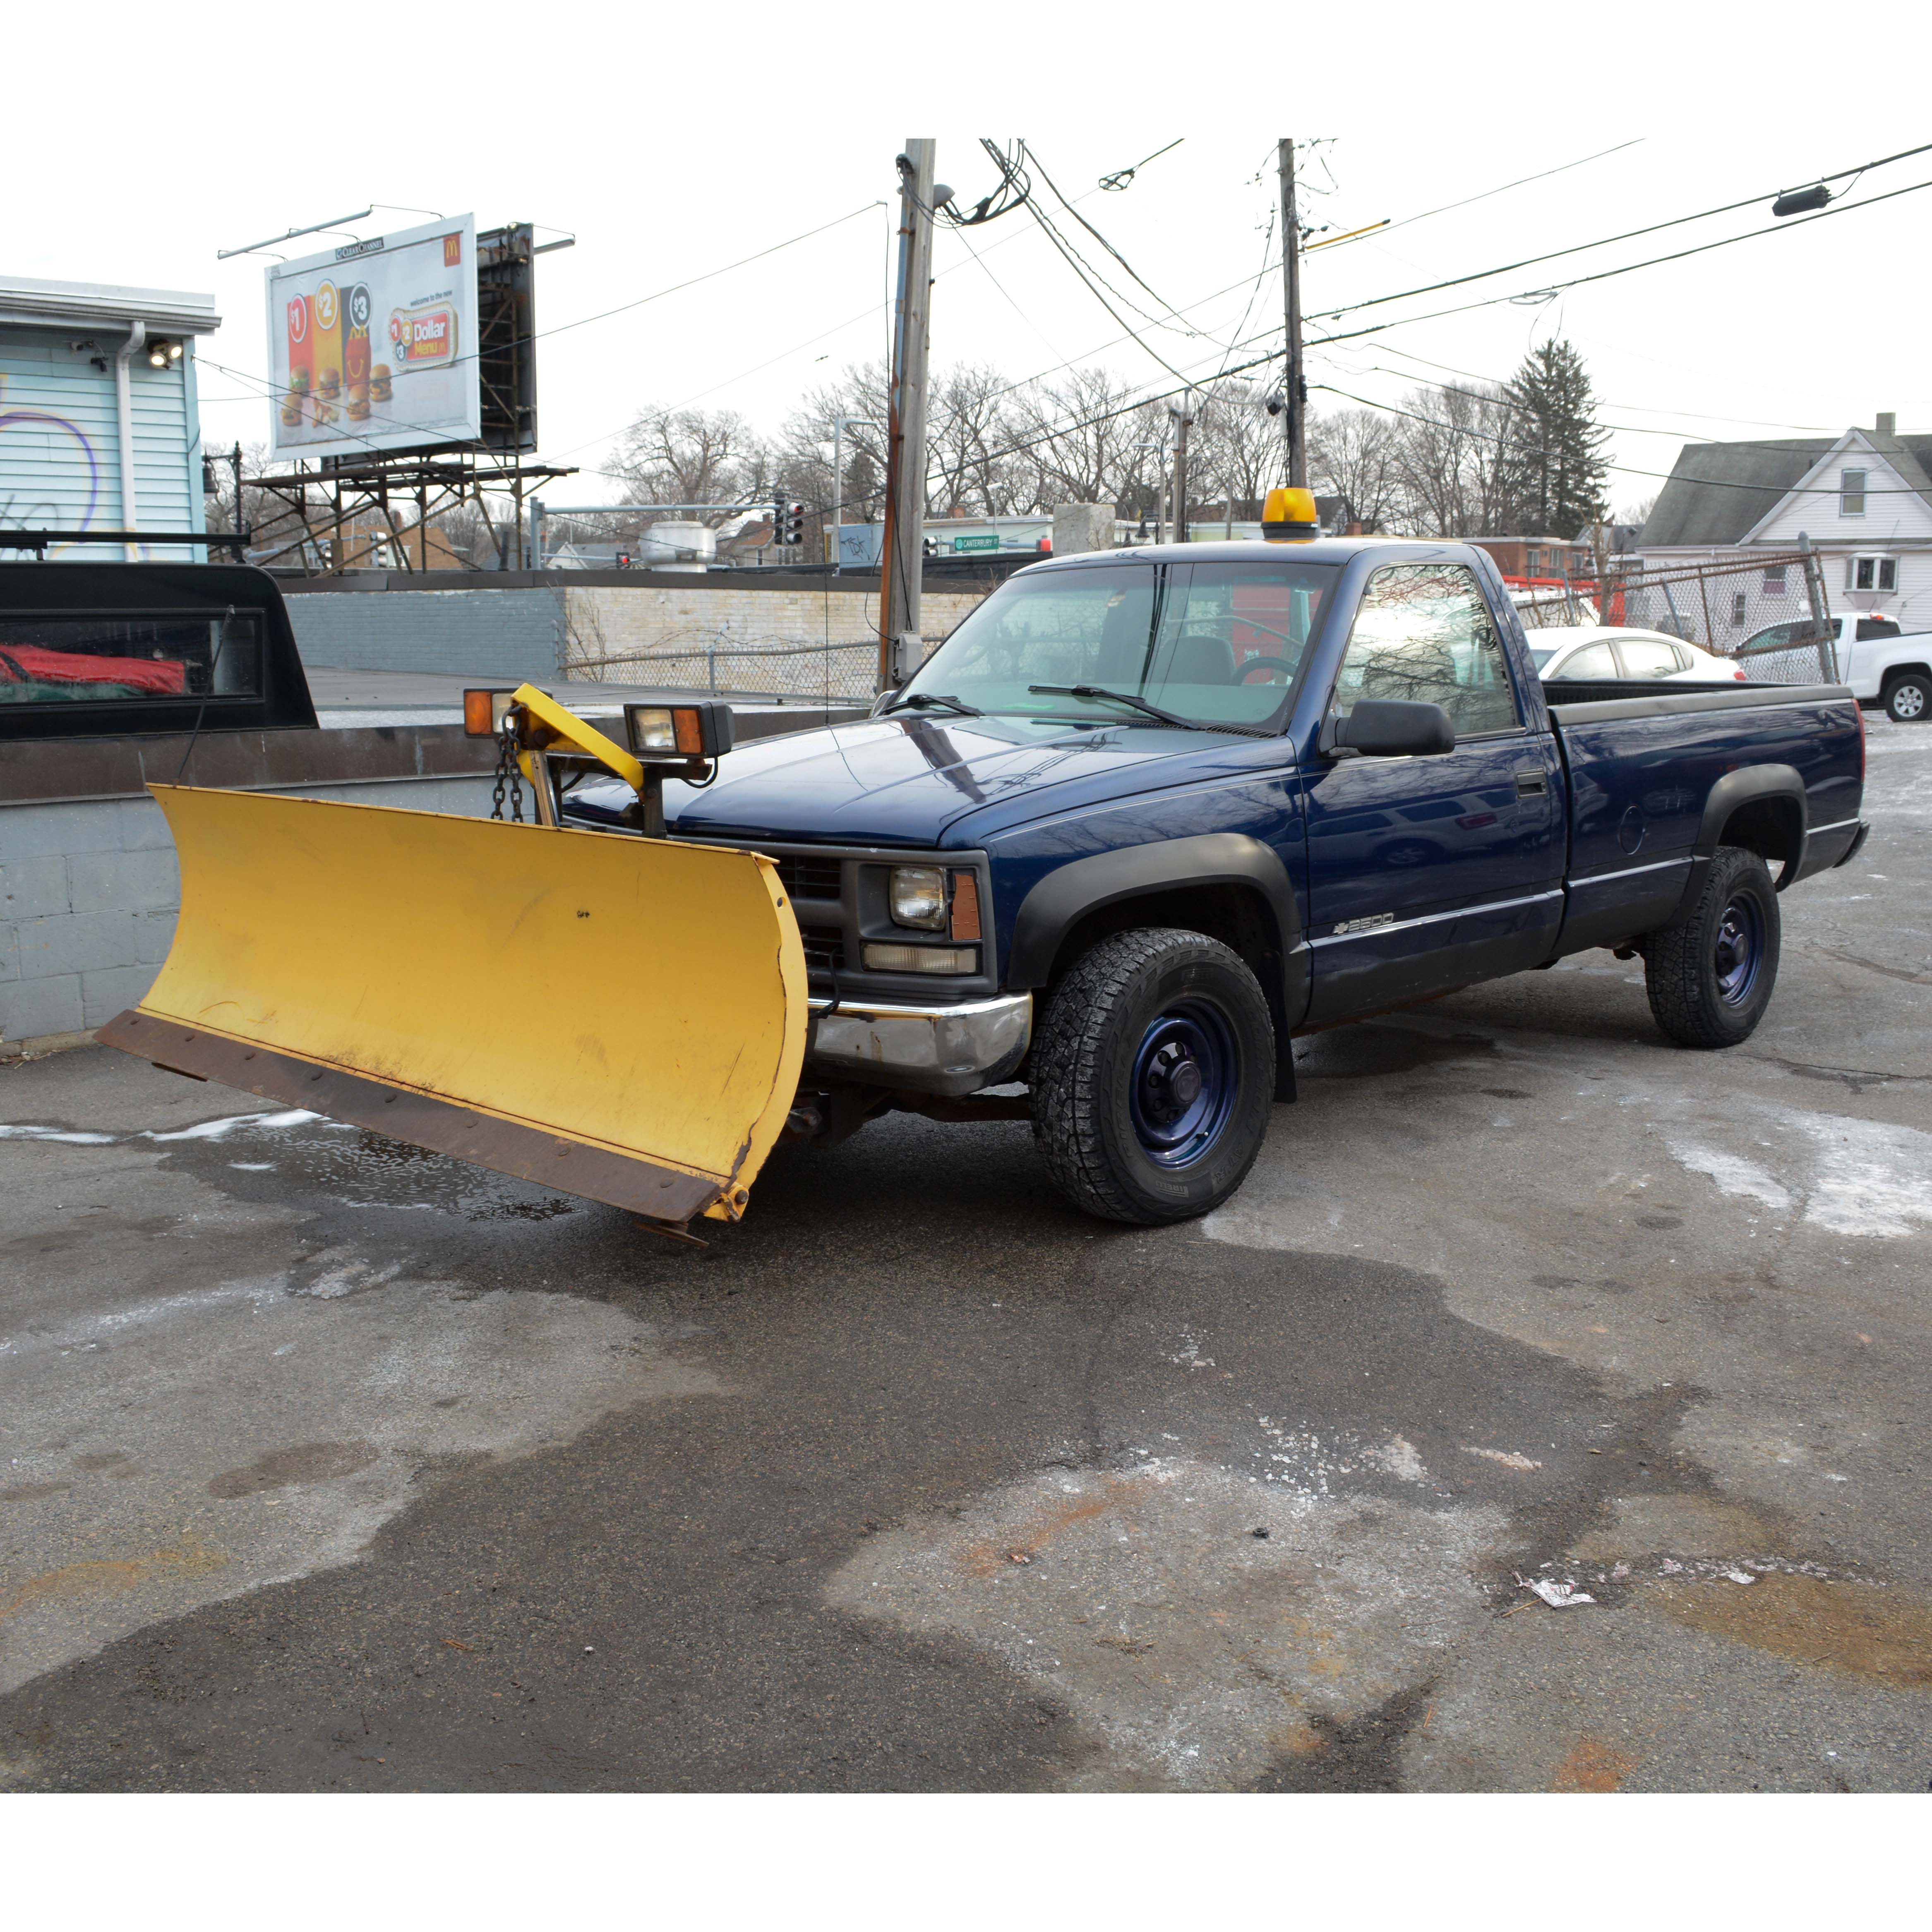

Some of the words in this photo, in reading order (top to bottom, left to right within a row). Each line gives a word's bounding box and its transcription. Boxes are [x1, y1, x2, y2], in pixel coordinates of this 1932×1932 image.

[343, 247, 359, 257] CLEAR
[359, 240, 383, 254] CHANNEL
[318, 291, 332, 318] $2
[354, 296, 368, 320] $3
[410, 297, 429, 307] welcome
[291, 307, 300, 331] $1
[391, 323, 398, 337] $1
[402, 325, 410, 340] $2
[414, 319, 445, 342] Dollar
[396, 344, 404, 360] $3
[414, 341, 437, 356] Menu
[963, 539, 993, 548] CANTERBURY
[1349, 913, 1394, 932] 2500
[1154, 1180, 1189, 1199] PIRELLI
